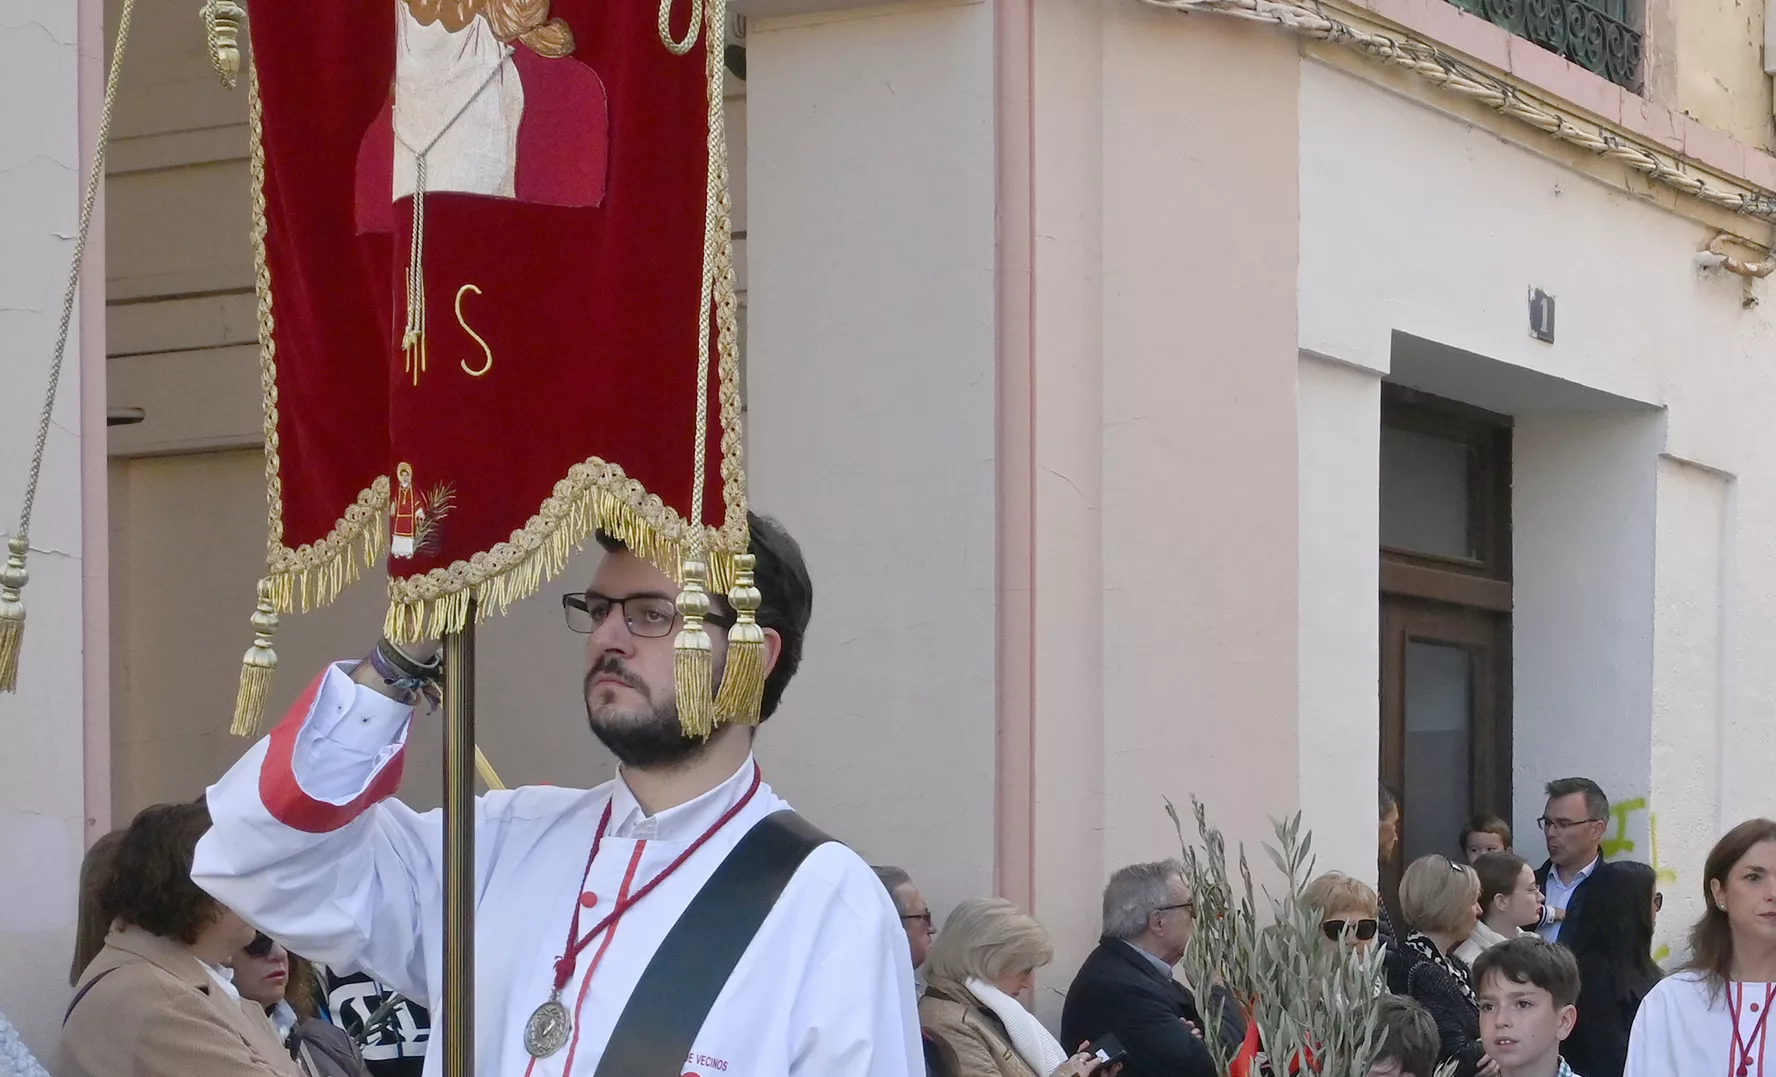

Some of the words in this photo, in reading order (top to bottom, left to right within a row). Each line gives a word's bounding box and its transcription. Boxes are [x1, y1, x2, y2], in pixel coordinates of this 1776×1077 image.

[454, 283, 493, 377] S
[1540, 297, 1548, 333] 1
[696, 1054, 729, 1072] VECINOS
